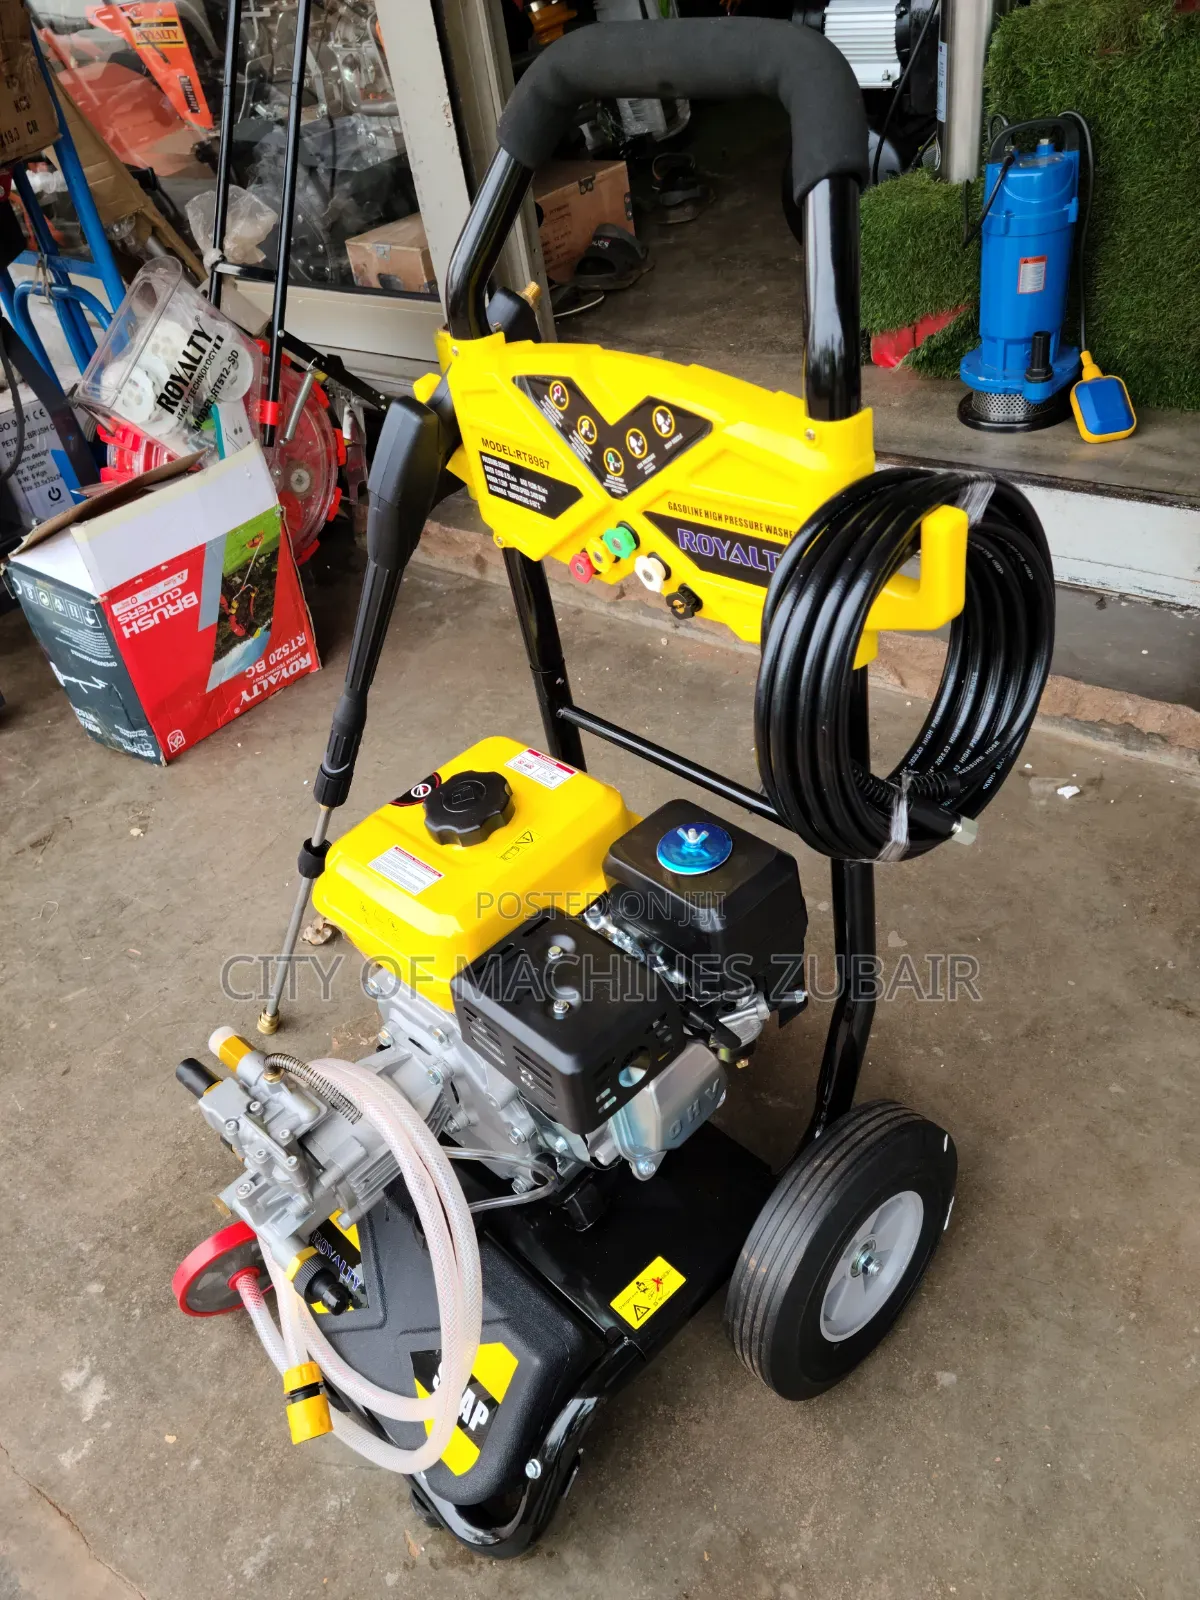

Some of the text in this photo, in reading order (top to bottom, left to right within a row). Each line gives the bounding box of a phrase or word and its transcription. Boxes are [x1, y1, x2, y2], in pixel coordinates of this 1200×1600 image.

[156, 322, 212, 415] ROYALTY
[176, 348, 218, 421] ITALY TECHNOLOGY
[27, 425, 49, 439] BRUSH
[481, 437, 550, 470] MODEL:RT8987
[668, 501, 796, 540] GASOLINE HIGH PRESSURE WASHE
[677, 527, 782, 573] ROYALT
[117, 587, 182, 626] CUTTERS
[121, 591, 199, 639] BRUSH
[245, 632, 306, 678] RT520 BC
[240, 652, 312, 706] ROYALTY
[922, 729, 934, 746] HIGH
[949, 728, 961, 744] HIGH
[985, 740, 1000, 755] HOSE
[959, 748, 972, 764] HIGH
[310, 1228, 362, 1291] ROYALTY
